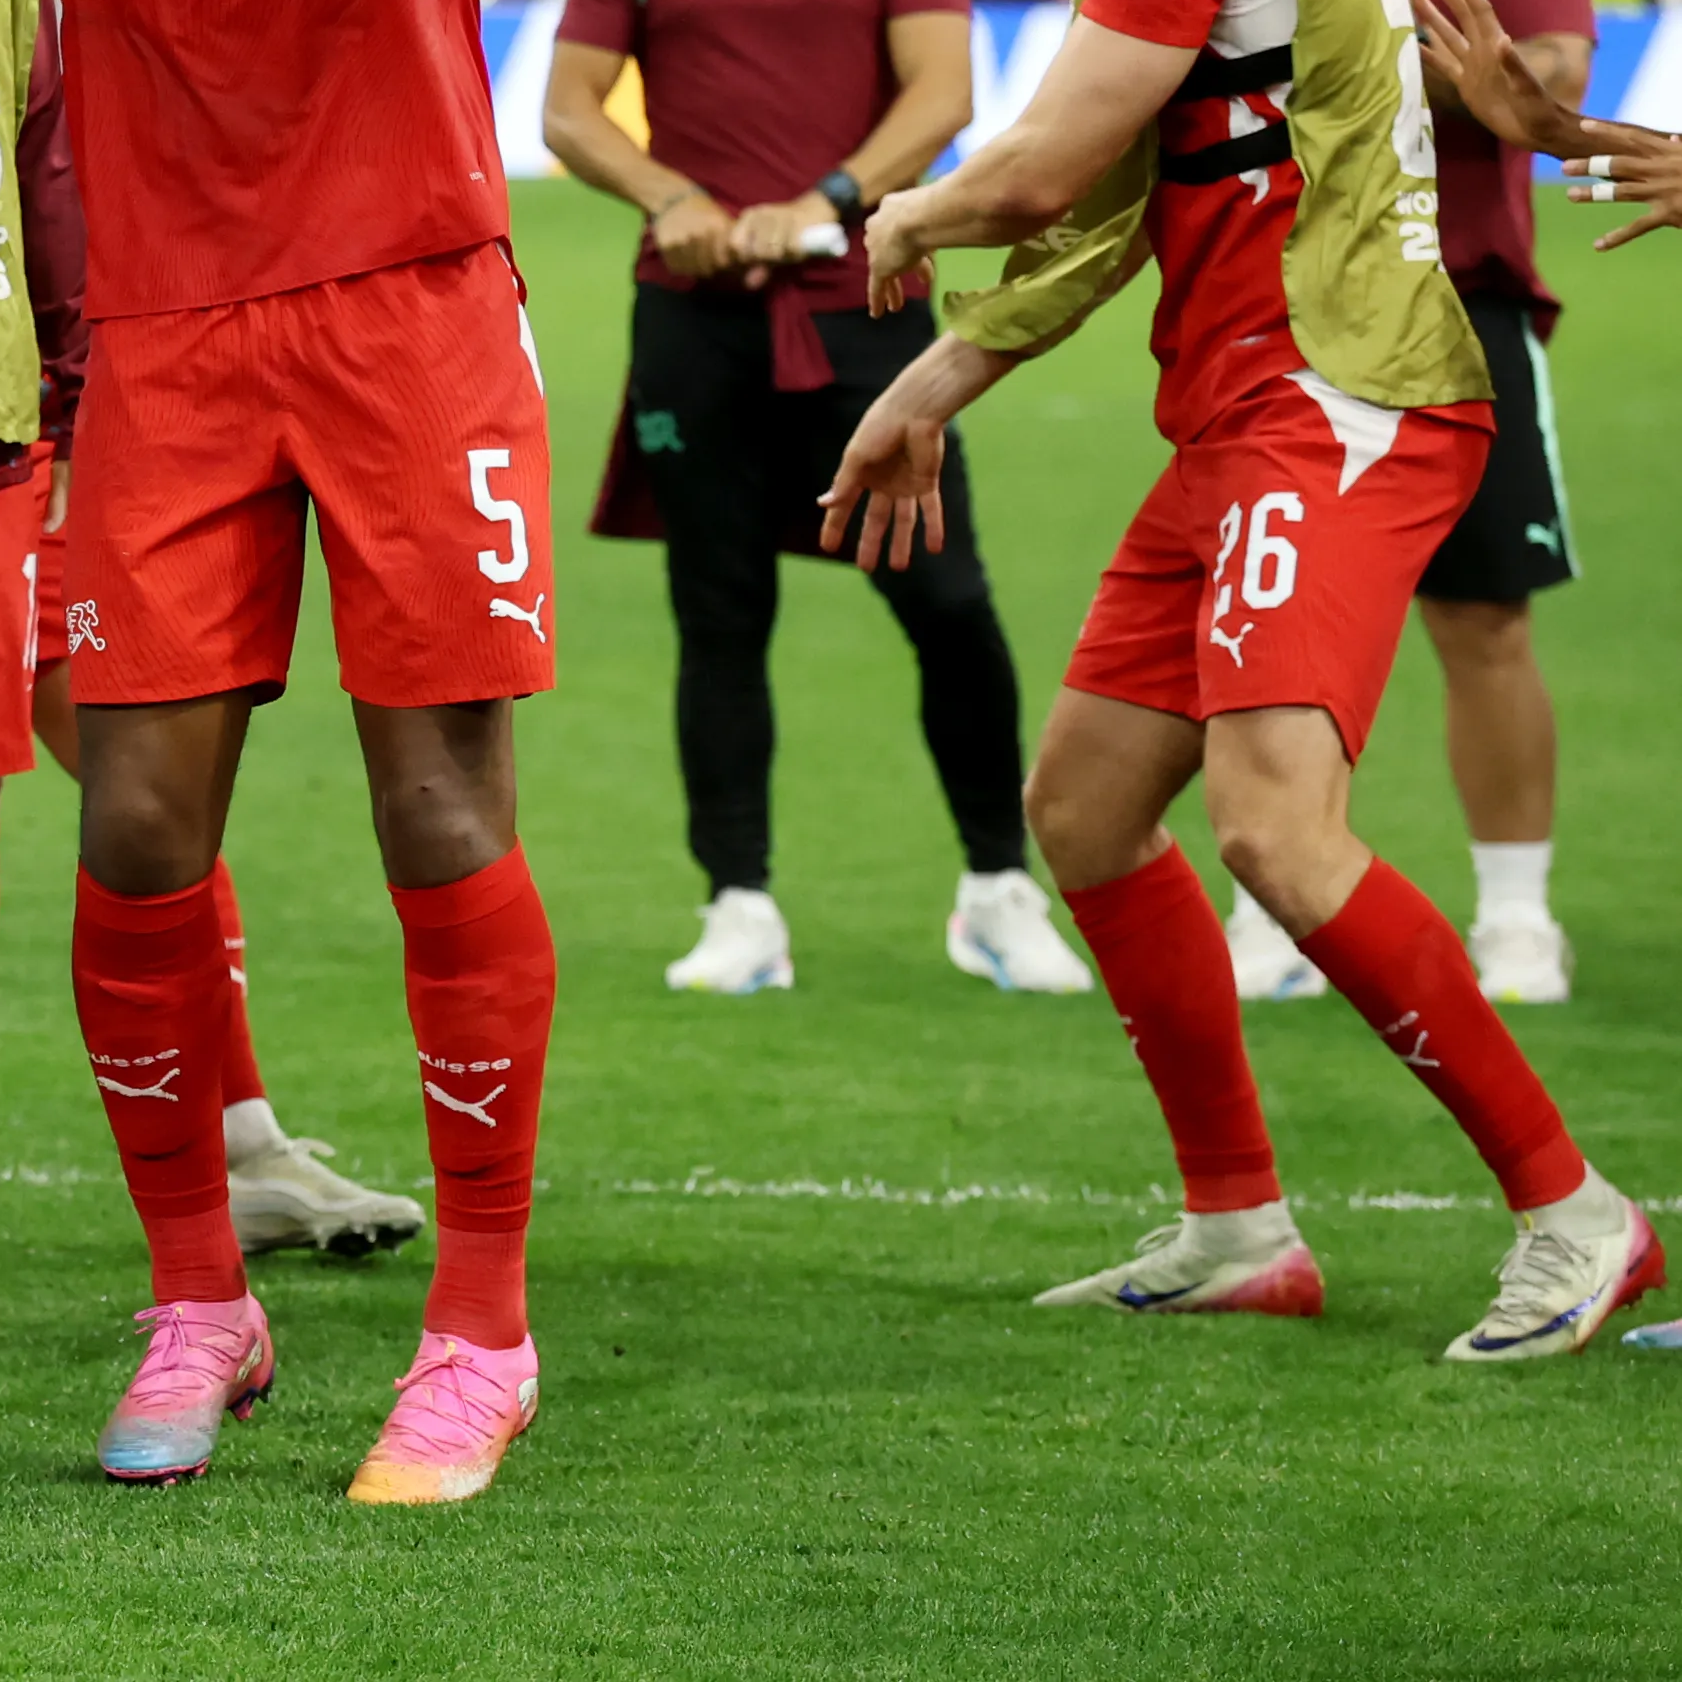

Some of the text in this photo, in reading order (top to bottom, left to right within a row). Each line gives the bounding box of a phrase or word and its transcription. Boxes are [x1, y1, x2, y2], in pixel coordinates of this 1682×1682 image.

[468, 449, 530, 584] 5
[1211, 492, 1305, 625] 26
[91, 1048, 180, 1068] uisse
